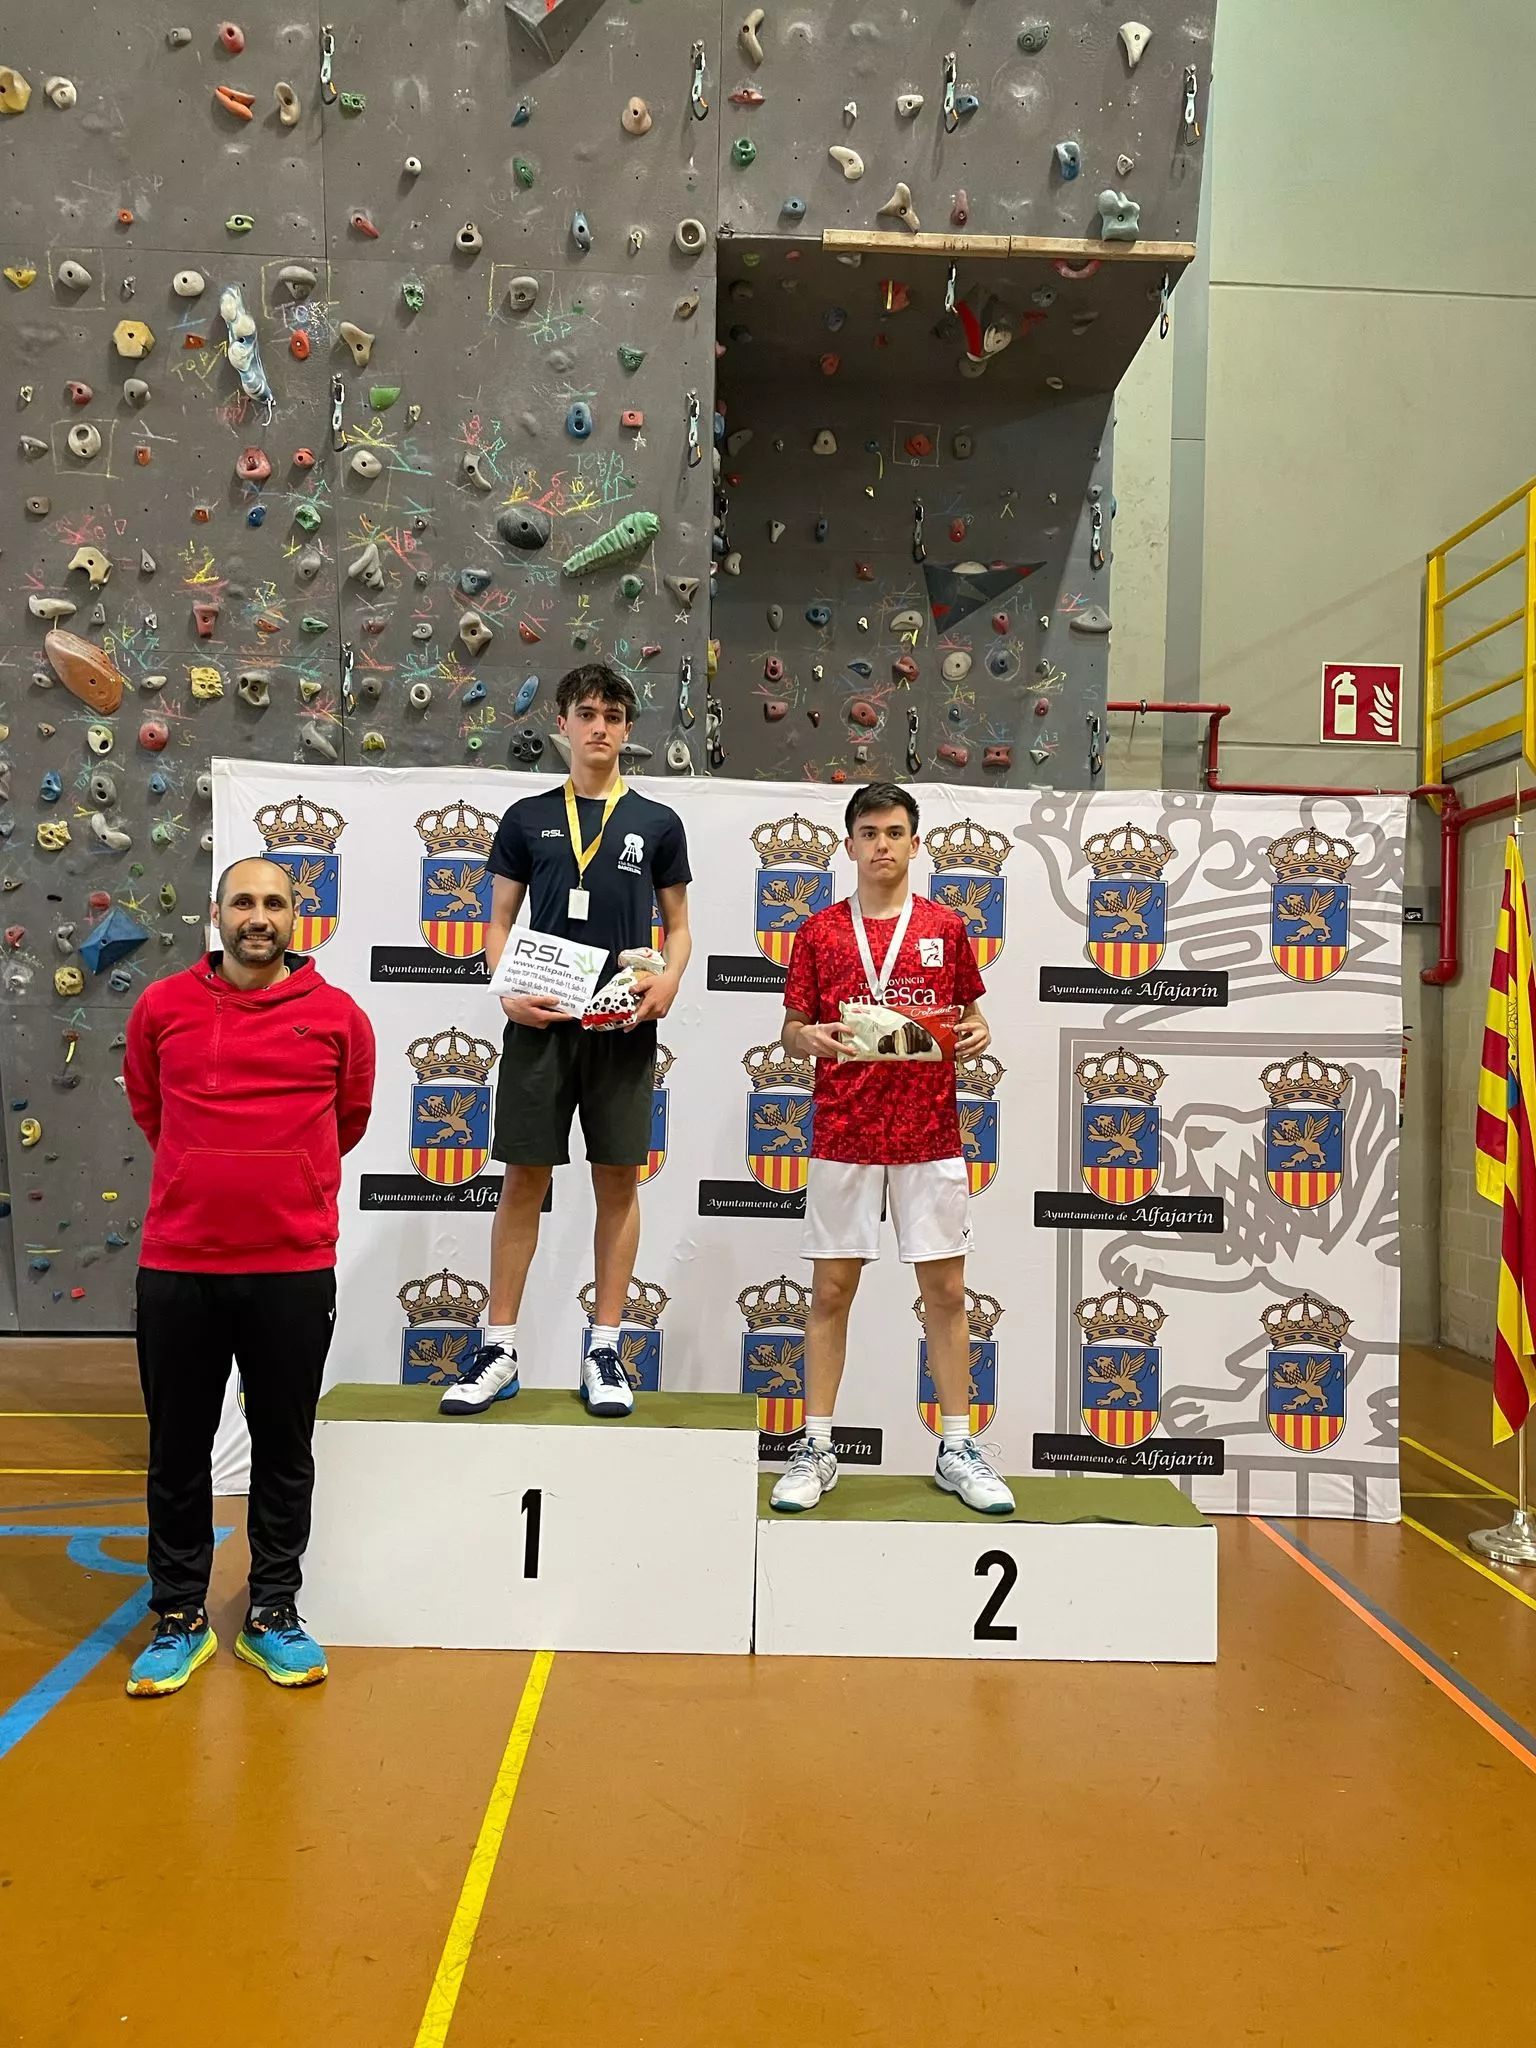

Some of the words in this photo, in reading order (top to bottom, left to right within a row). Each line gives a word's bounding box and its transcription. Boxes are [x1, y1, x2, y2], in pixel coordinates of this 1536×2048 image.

[541, 829, 564, 838] RSL
[514, 939, 570, 968] RSL
[379, 964, 452, 976] Ayuntamiento
[454, 965, 466, 975] de
[513, 960, 584, 982] www.rslspain.es
[715, 973, 786, 985] Ayuntamiento
[1047, 984, 1119, 996] Ayuntamiento
[1121, 985, 1133, 995] de
[1136, 981, 1218, 1001] Alfajarín
[368, 1192, 442, 1204] Ayuntamiento
[443, 1192, 456, 1202] de
[706, 1198, 779, 1210] Ayuntamiento
[780, 1199, 792, 1209] de
[1042, 1209, 1114, 1221] Ayuntamiento
[1116, 1211, 1128, 1221] de
[1131, 1206, 1214, 1227] Alfajarín
[773, 1442, 785, 1452] de
[1040, 1451, 1114, 1463] Ayuntamiento
[1116, 1454, 1128, 1465] de
[1131, 1450, 1214, 1471] Alfajarín
[521, 1488, 542, 1579] 1
[973, 1549, 1018, 1641] 2
